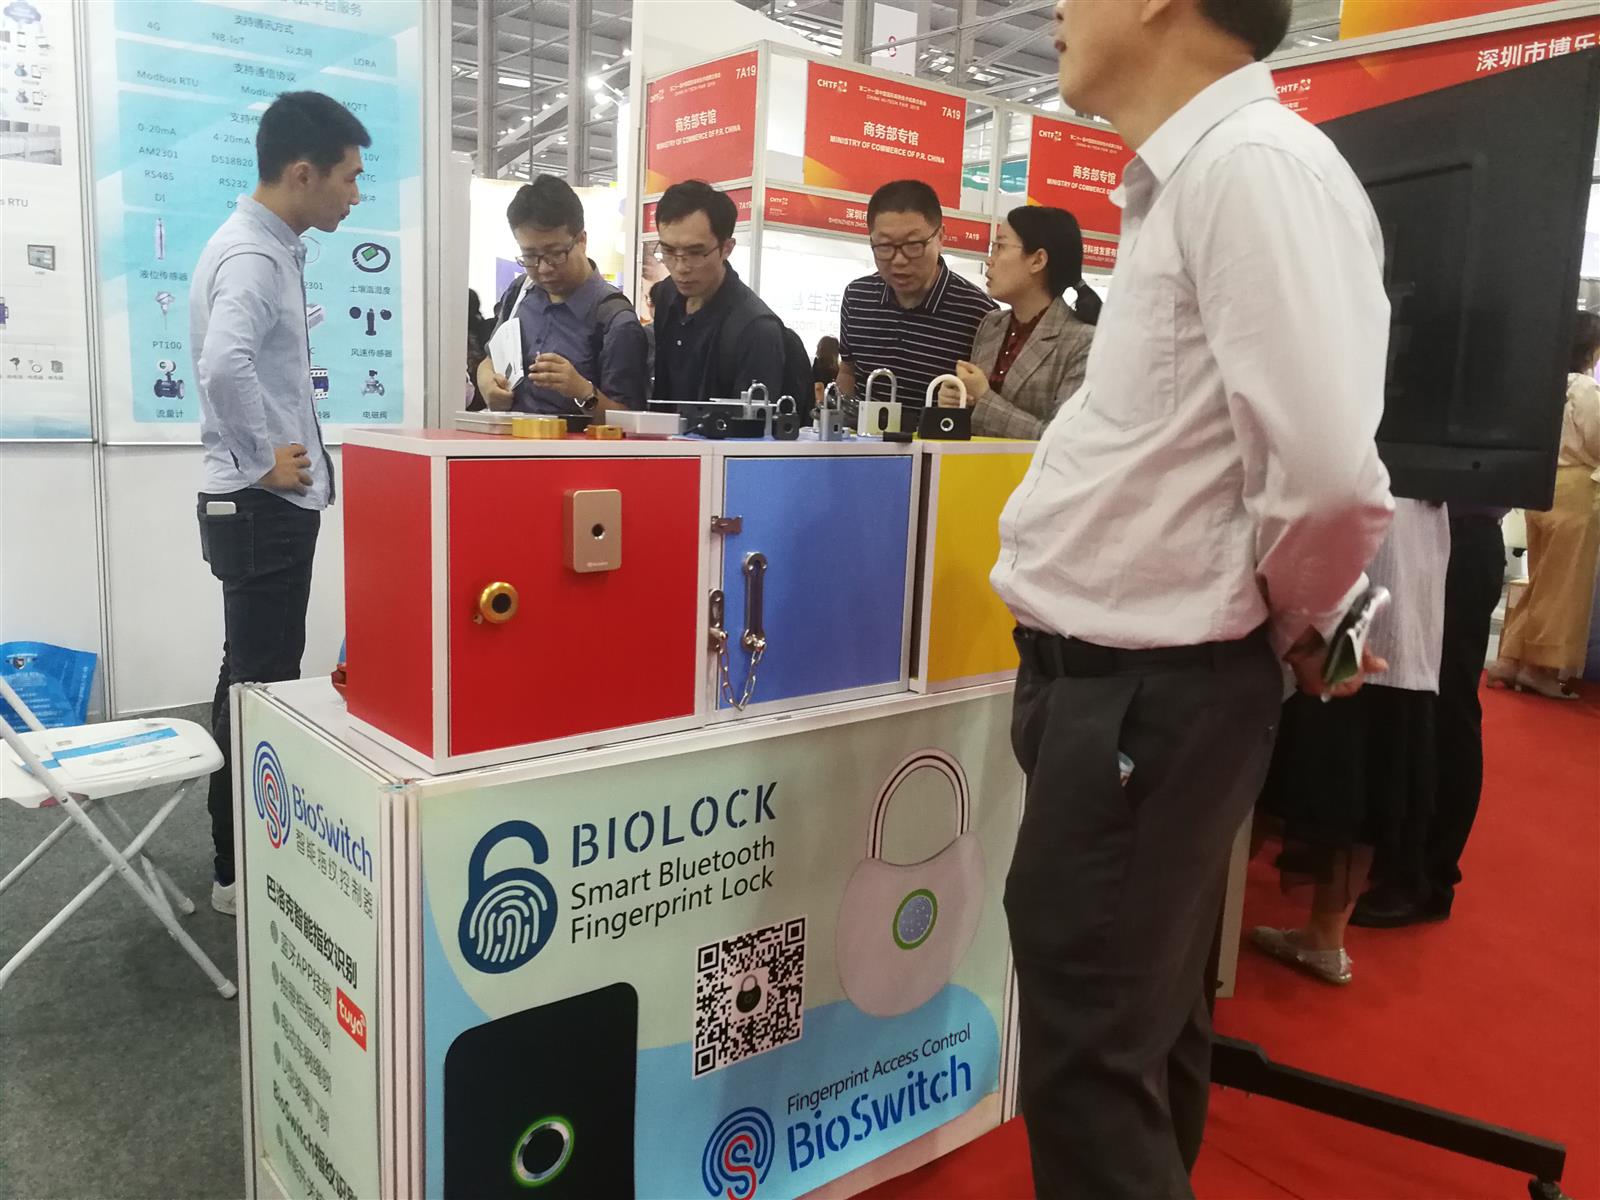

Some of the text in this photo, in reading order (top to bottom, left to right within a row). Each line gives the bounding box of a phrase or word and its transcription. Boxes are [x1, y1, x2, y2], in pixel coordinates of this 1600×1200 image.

[146, 21, 161, 32] 4G
[353, 57, 377, 69] LORA
[735, 64, 757, 80] 7A19
[137, 70, 199, 88] Modbus RTU
[817, 79, 838, 89] CHTF
[1275, 83, 1300, 94] CHTF
[675, 108, 717, 132] 商务部专馆
[942, 106, 961, 120] 7A19
[137, 122, 177, 136] 0-20mA
[863, 121, 919, 146] 商务部专馆
[138, 146, 178, 160] AM2301
[829, 135, 861, 147] MINISTRY
[871, 143, 906, 156] COMMERCE
[927, 154, 945, 164] CHINA
[144, 169, 175, 182] RS485
[219, 178, 248, 190] RS232
[1073, 165, 1116, 185] 商务部专馆
[7, 197, 29, 208] RTU
[152, 341, 182, 350] PT100
[292, 783, 373, 882] BioSwitch
[571, 781, 778, 869] BIOLOCK
[295, 828, 373, 919] 智能指纹控制器
[571, 835, 775, 910] Smart Bluetooth
[571, 865, 774, 944] Fingerprint Lock
[265, 874, 357, 989] 巴洛克智能指纹识别
[338, 998, 363, 1037] tuya
[787, 1023, 971, 1115] Fingerprint Access Control
[786, 1054, 972, 1172] BioSwitch
